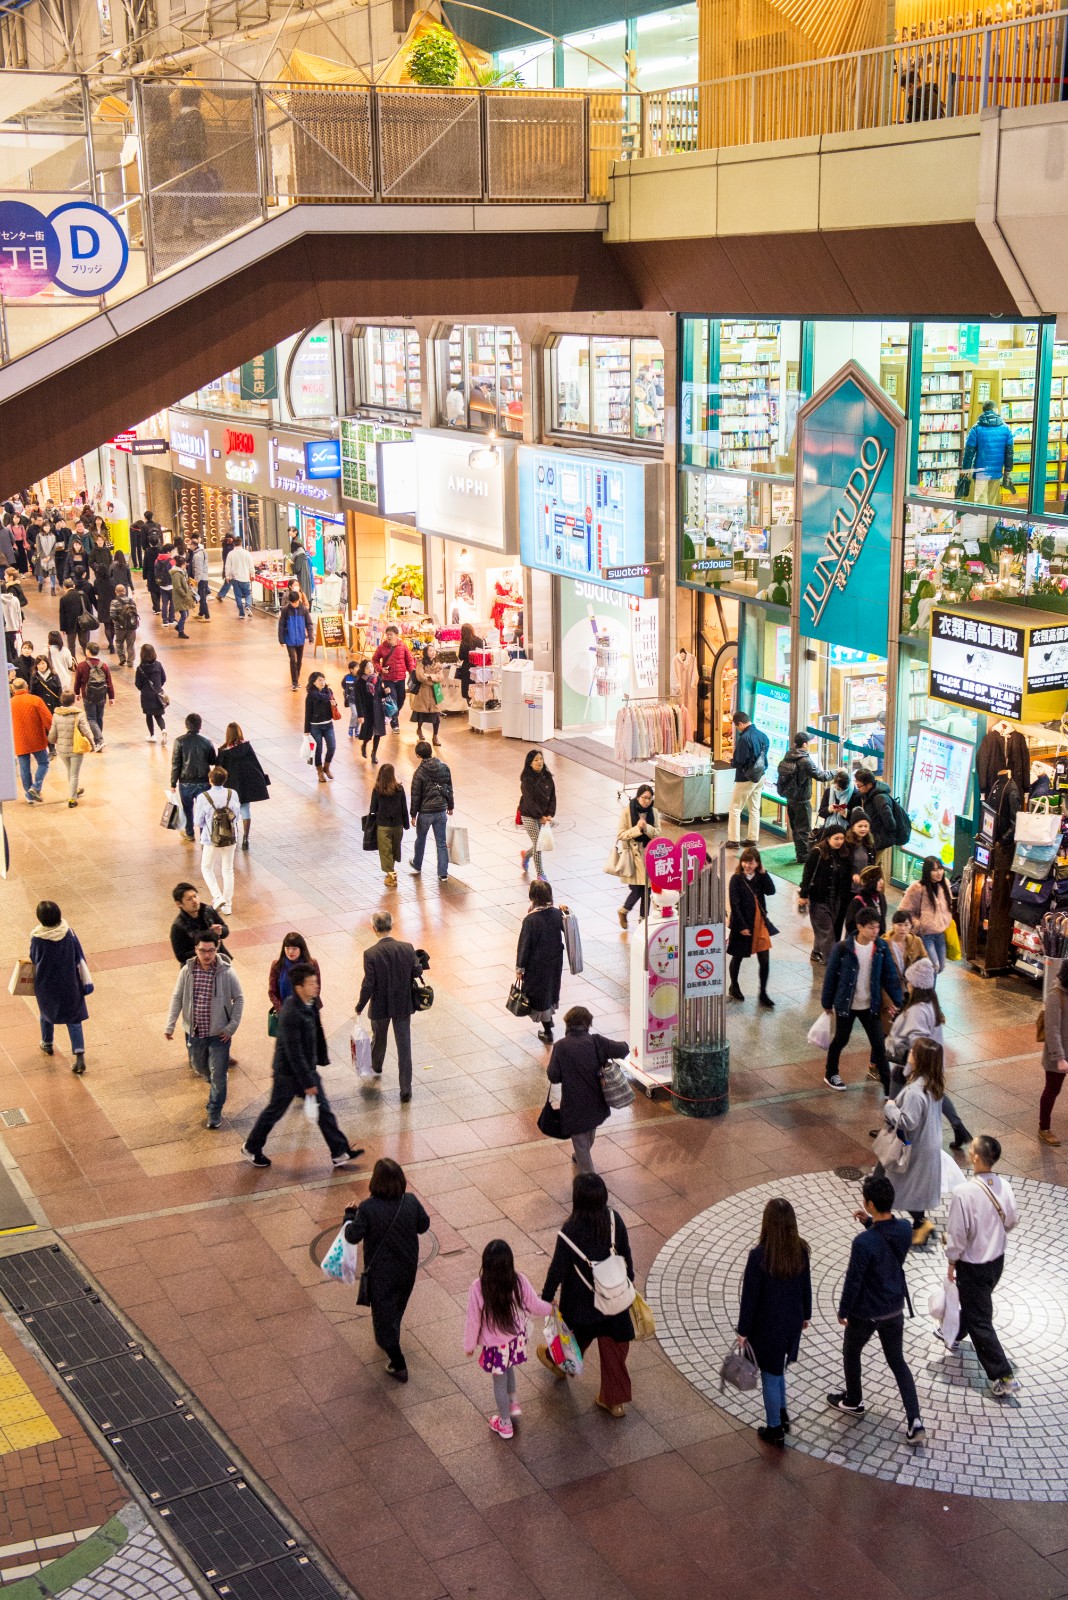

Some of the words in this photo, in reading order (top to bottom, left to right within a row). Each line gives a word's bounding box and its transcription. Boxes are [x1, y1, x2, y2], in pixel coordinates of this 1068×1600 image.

[69, 225, 101, 260] D
[71, 265, 103, 274] ブリッジ
[447, 474, 490, 497] AMPHI
[802, 435, 882, 622] JUNKUDO
[607, 566, 644, 579] swatch
[938, 615, 1019, 652] 衣類高価買取
[666, 875, 683, 883] ルー
